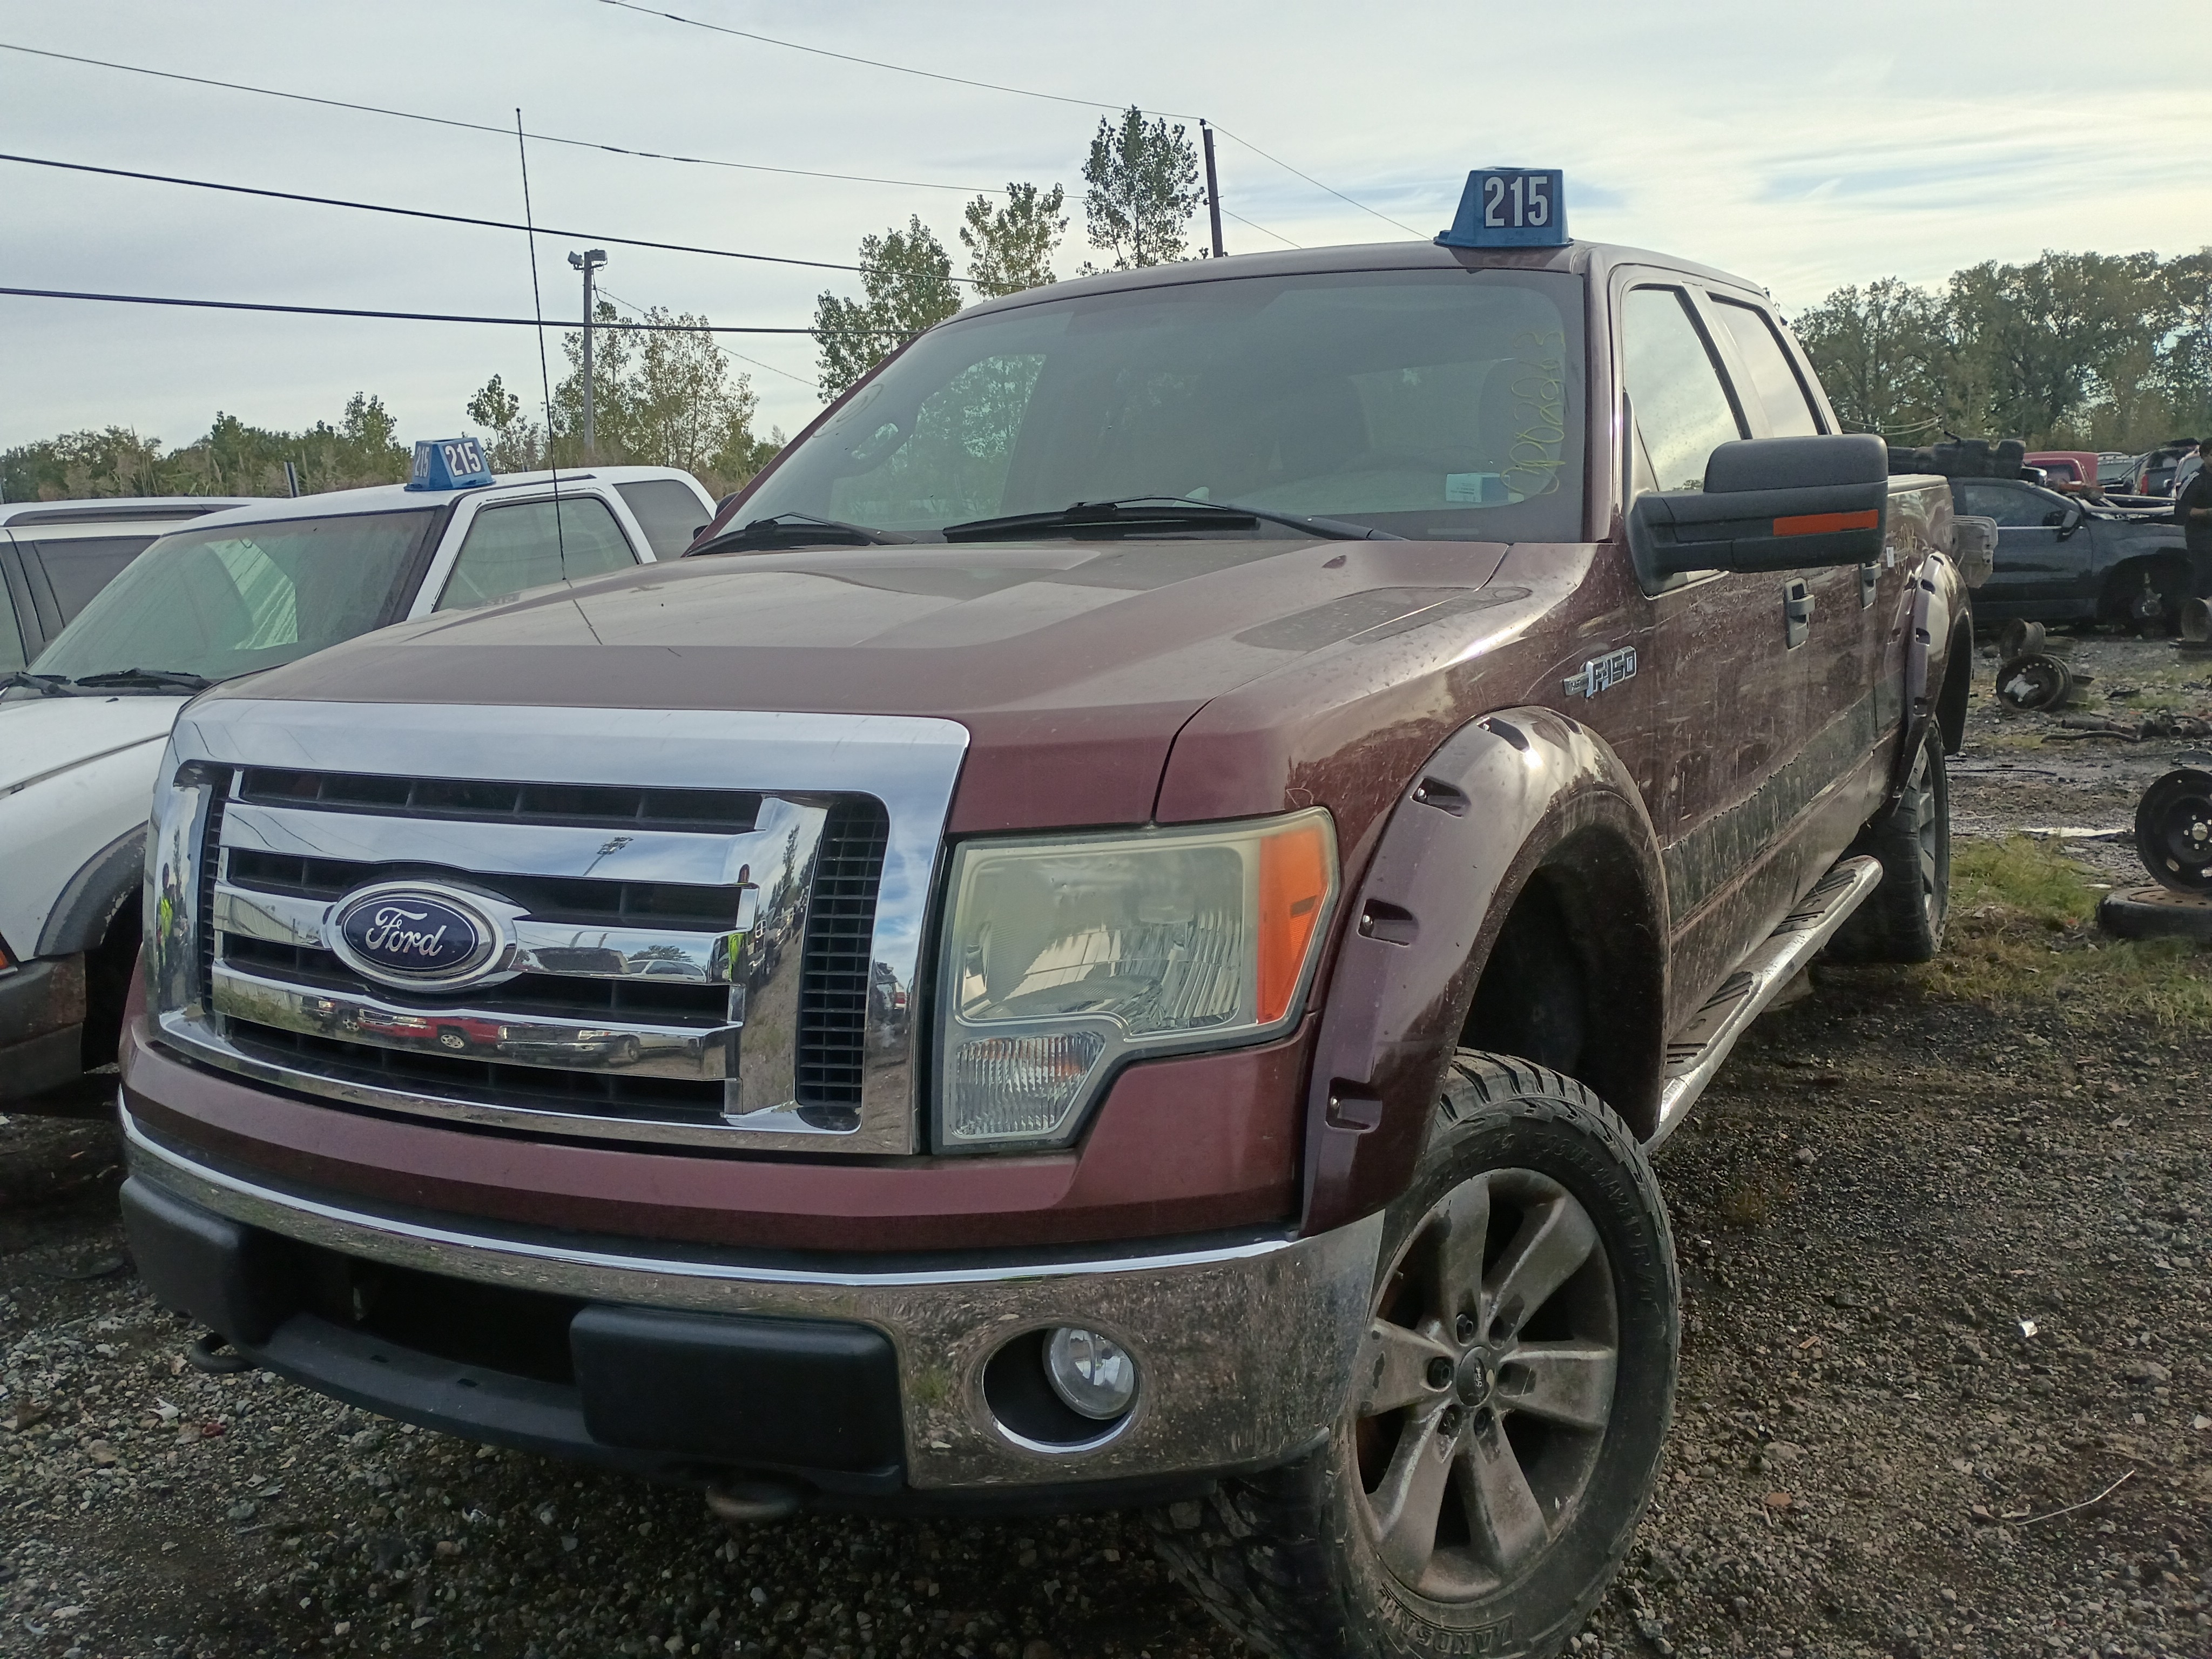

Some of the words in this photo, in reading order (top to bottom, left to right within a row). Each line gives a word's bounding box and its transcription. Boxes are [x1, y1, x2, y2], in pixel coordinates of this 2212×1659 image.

[1485, 176, 1548, 227] 215
[414, 446, 430, 477] 215
[445, 442, 481, 476] 215
[366, 907, 447, 956] Ford
